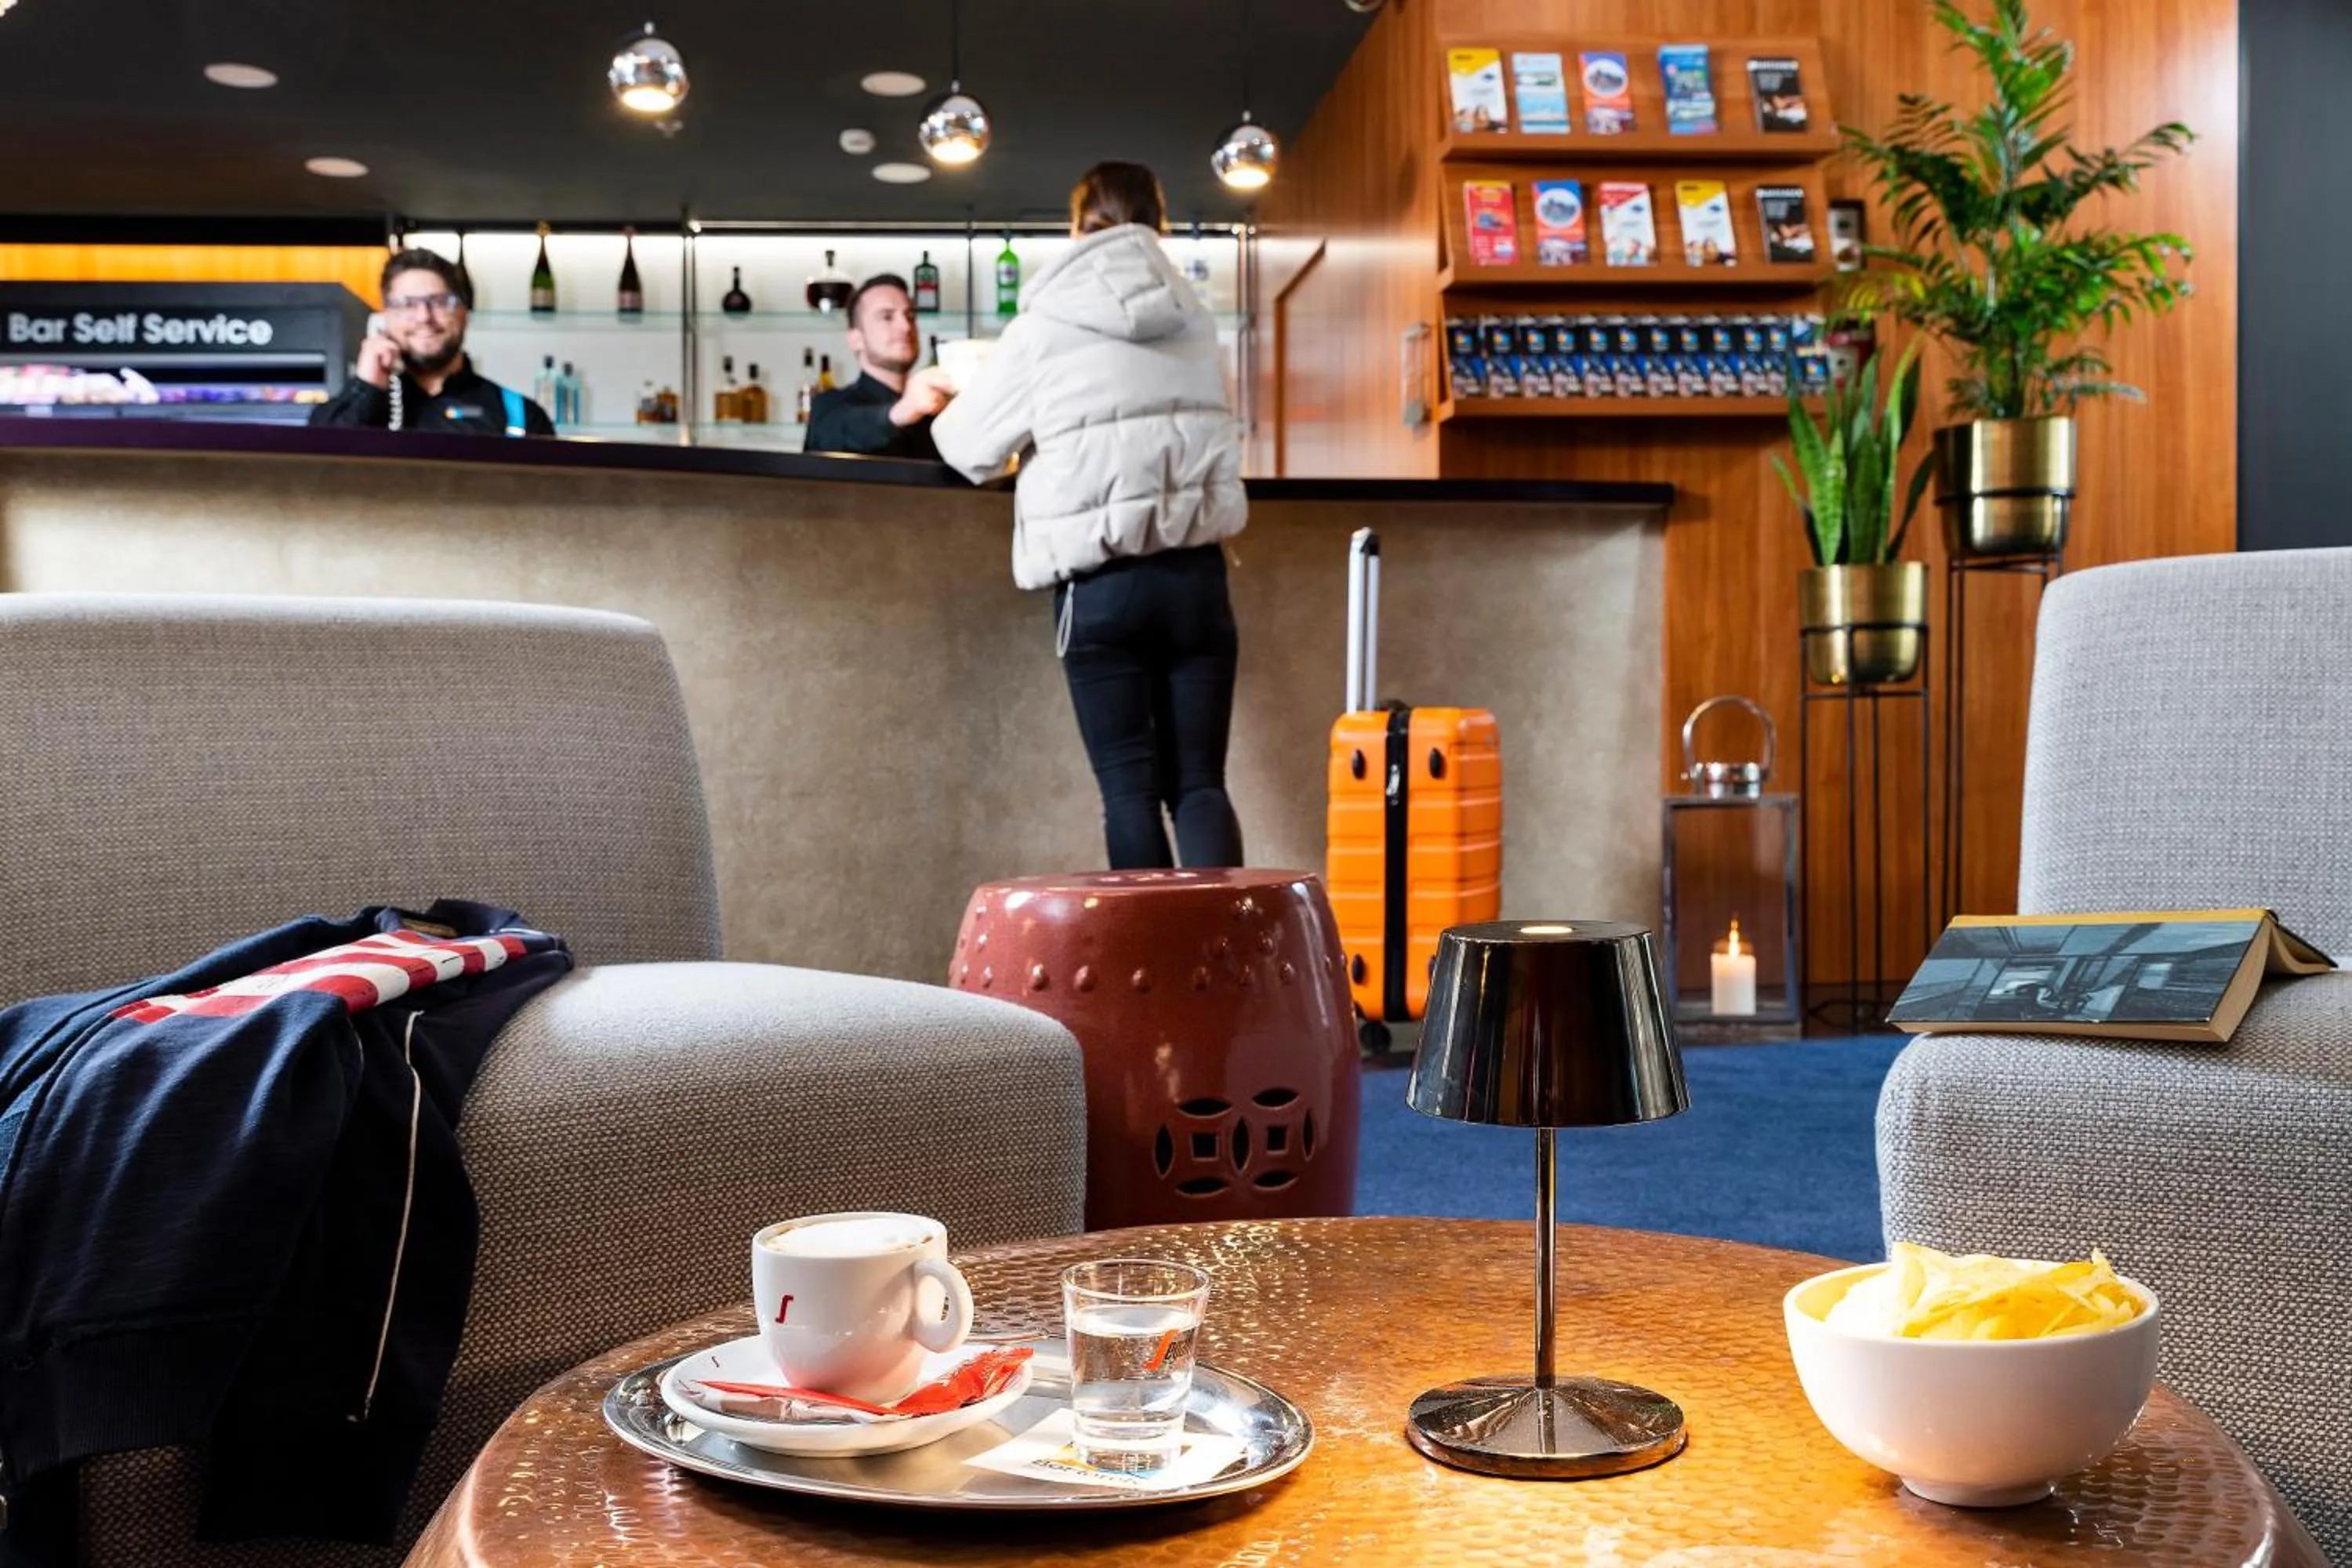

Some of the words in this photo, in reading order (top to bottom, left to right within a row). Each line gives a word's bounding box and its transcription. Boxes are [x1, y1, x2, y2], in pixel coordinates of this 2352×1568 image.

[8, 313, 66, 343] Bar
[73, 312, 137, 343] Self
[142, 313, 274, 346] Service
